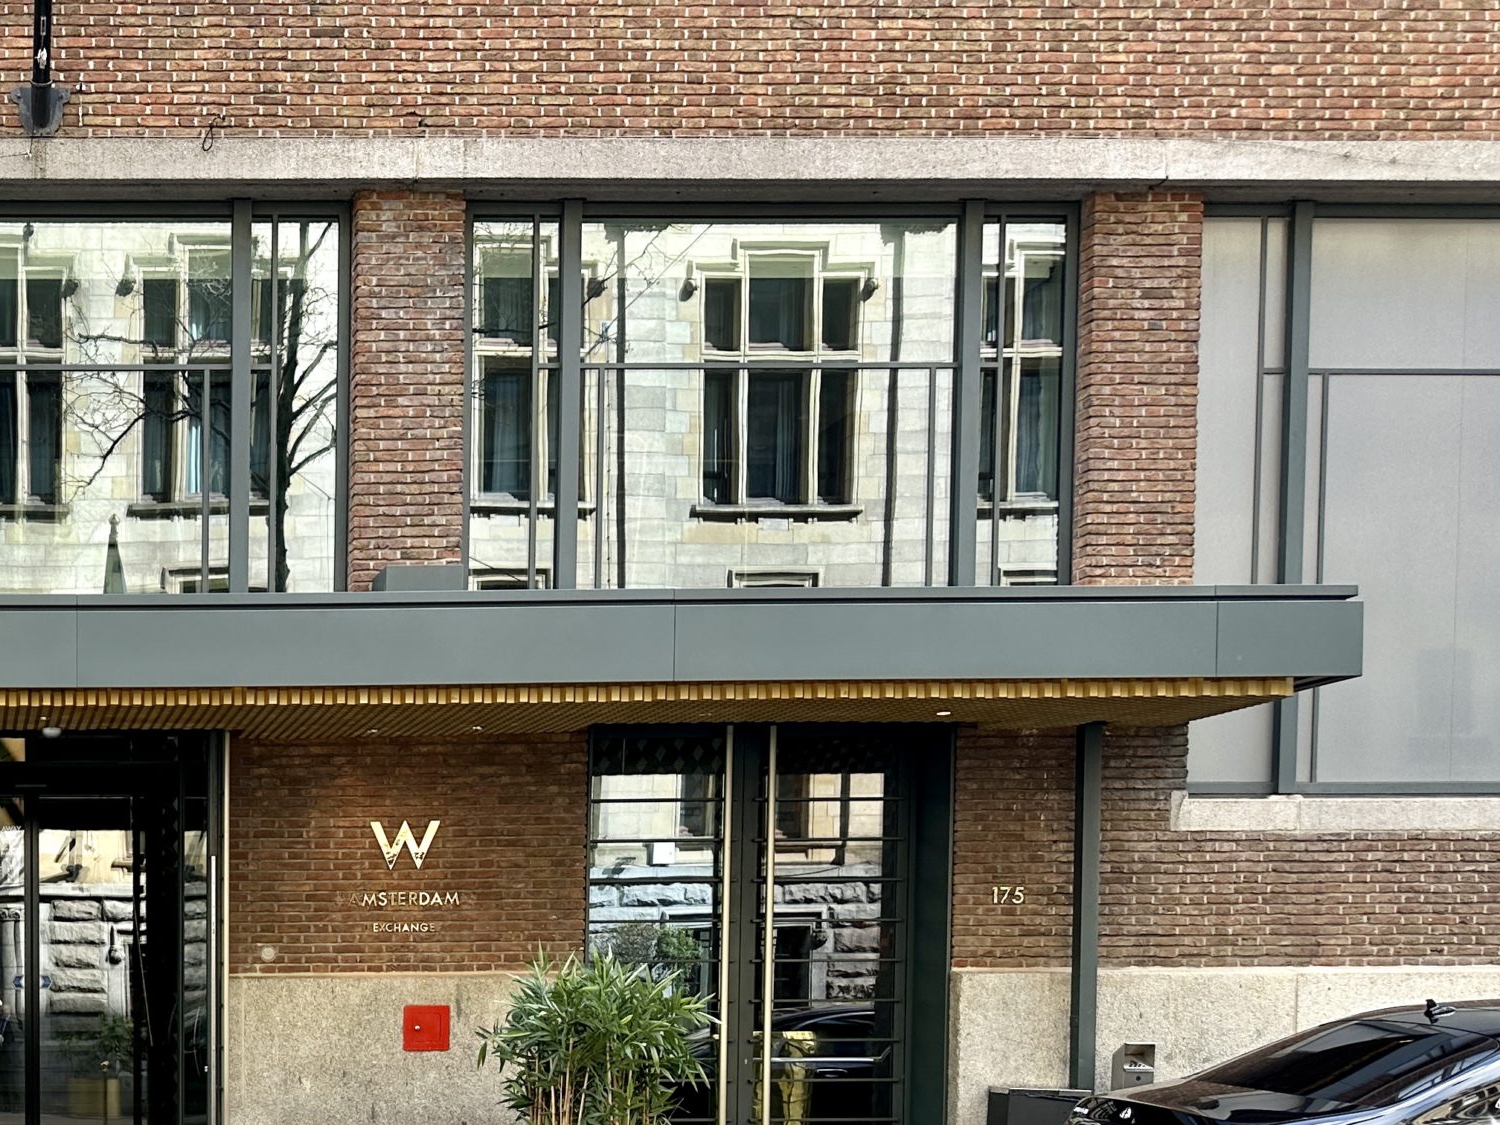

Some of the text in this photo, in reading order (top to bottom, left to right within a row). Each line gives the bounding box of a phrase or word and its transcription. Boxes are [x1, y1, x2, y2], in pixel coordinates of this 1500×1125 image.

[370, 820, 441, 870] W
[348, 891, 460, 907] AMSTERDAM
[991, 886, 1025, 904] 175
[372, 922, 436, 932] EXCHANGE
